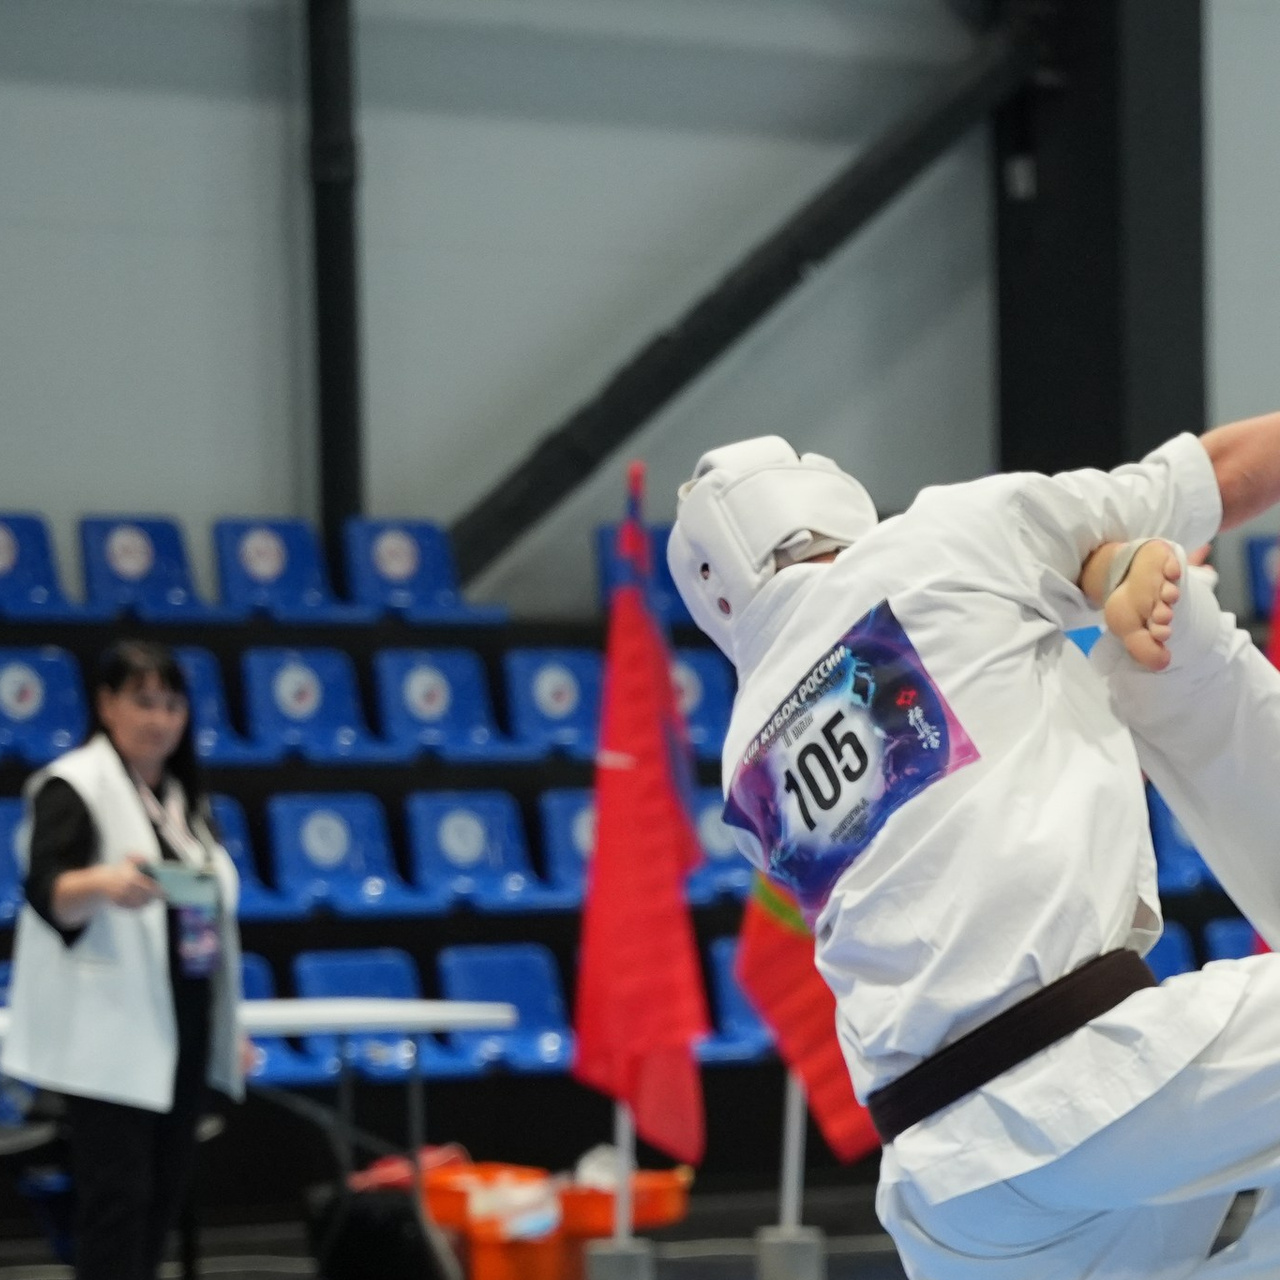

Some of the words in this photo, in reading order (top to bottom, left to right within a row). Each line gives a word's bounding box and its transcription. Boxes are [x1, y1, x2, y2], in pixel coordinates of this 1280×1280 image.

[761, 694, 801, 745] КУБОК
[798, 645, 845, 702] РОССИИ
[785, 710, 868, 831] 105
